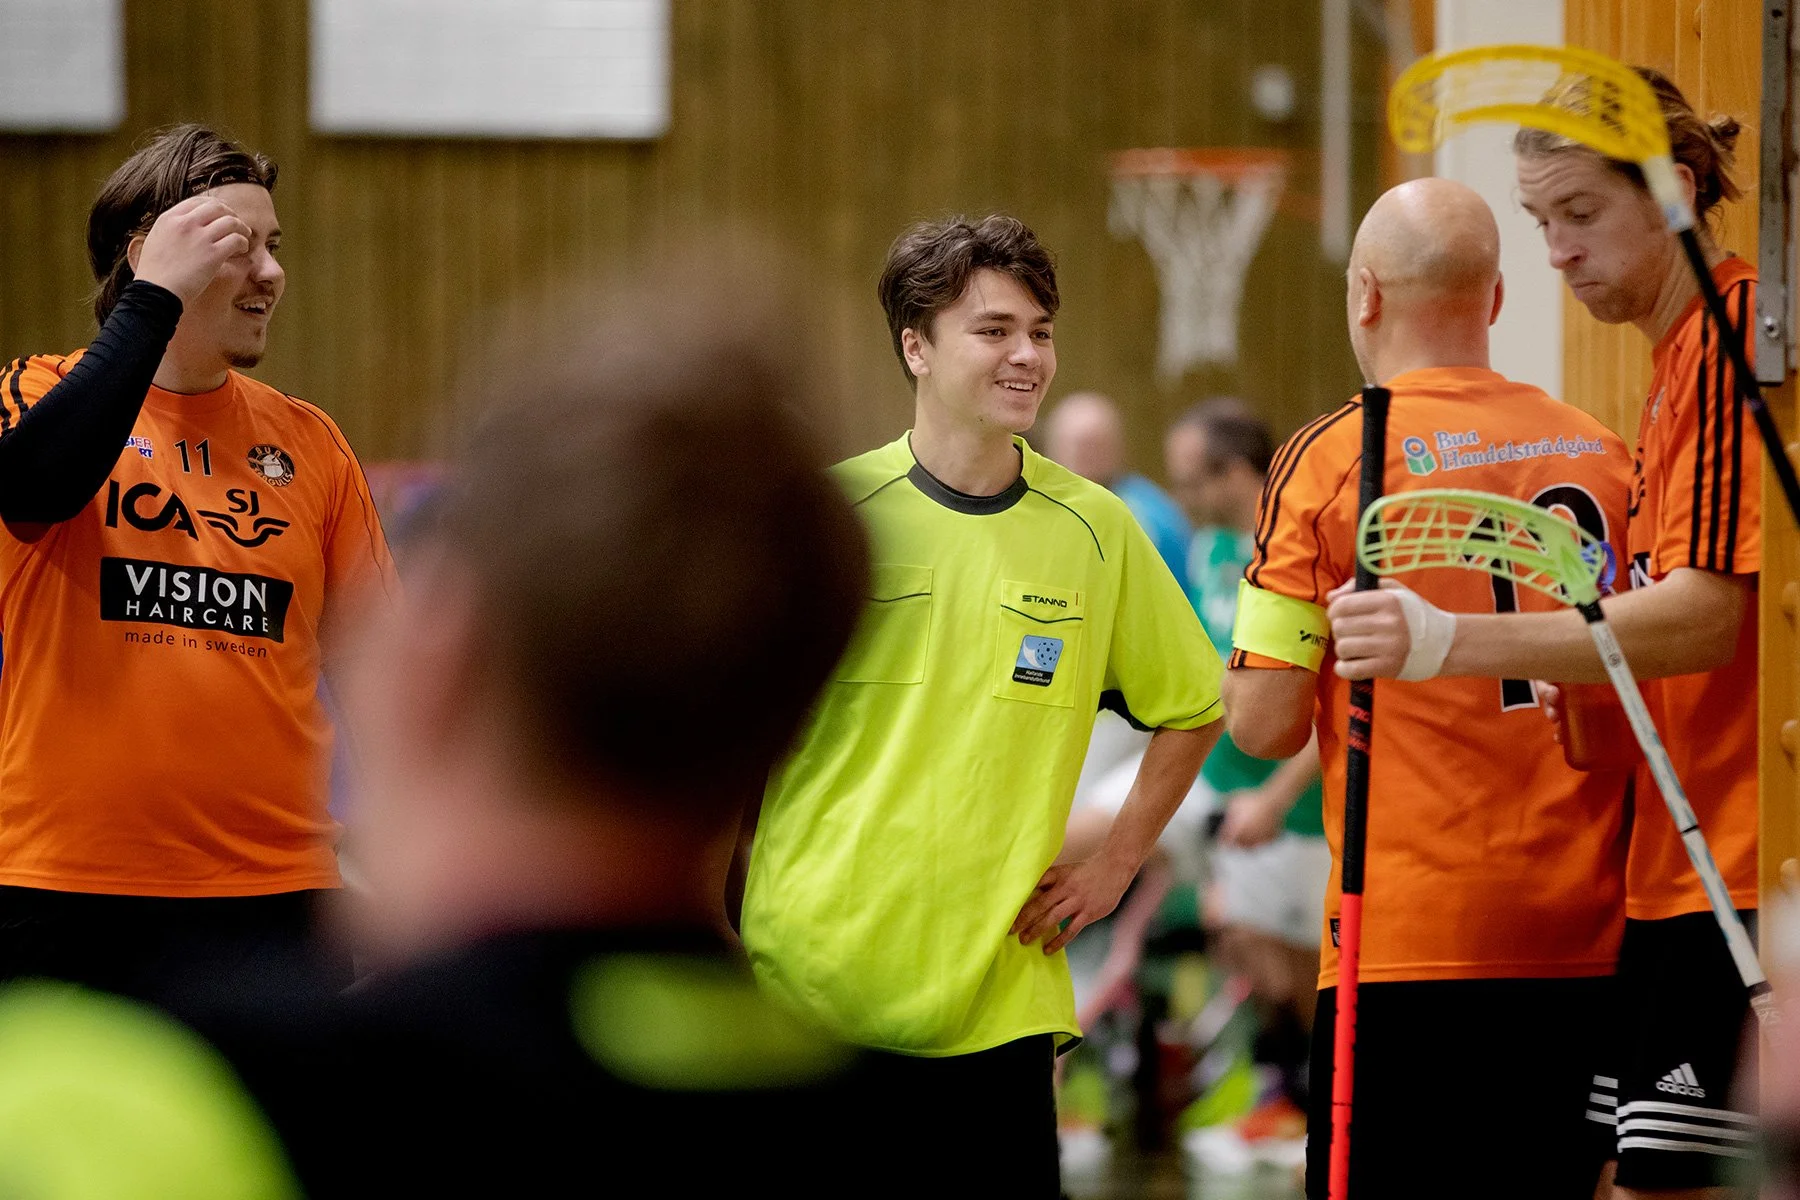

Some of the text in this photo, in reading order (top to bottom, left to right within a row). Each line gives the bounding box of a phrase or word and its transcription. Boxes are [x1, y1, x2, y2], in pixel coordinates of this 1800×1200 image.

[1434, 430, 1479, 450] Bua
[174, 438, 213, 477] 11
[105, 479, 199, 541] ICA
[226, 488, 260, 516] SJ
[125, 564, 267, 612] VISION
[1022, 594, 1068, 608] STANNO
[126, 600, 269, 632] HAIRCARE
[125, 631, 267, 658] made in sweden
